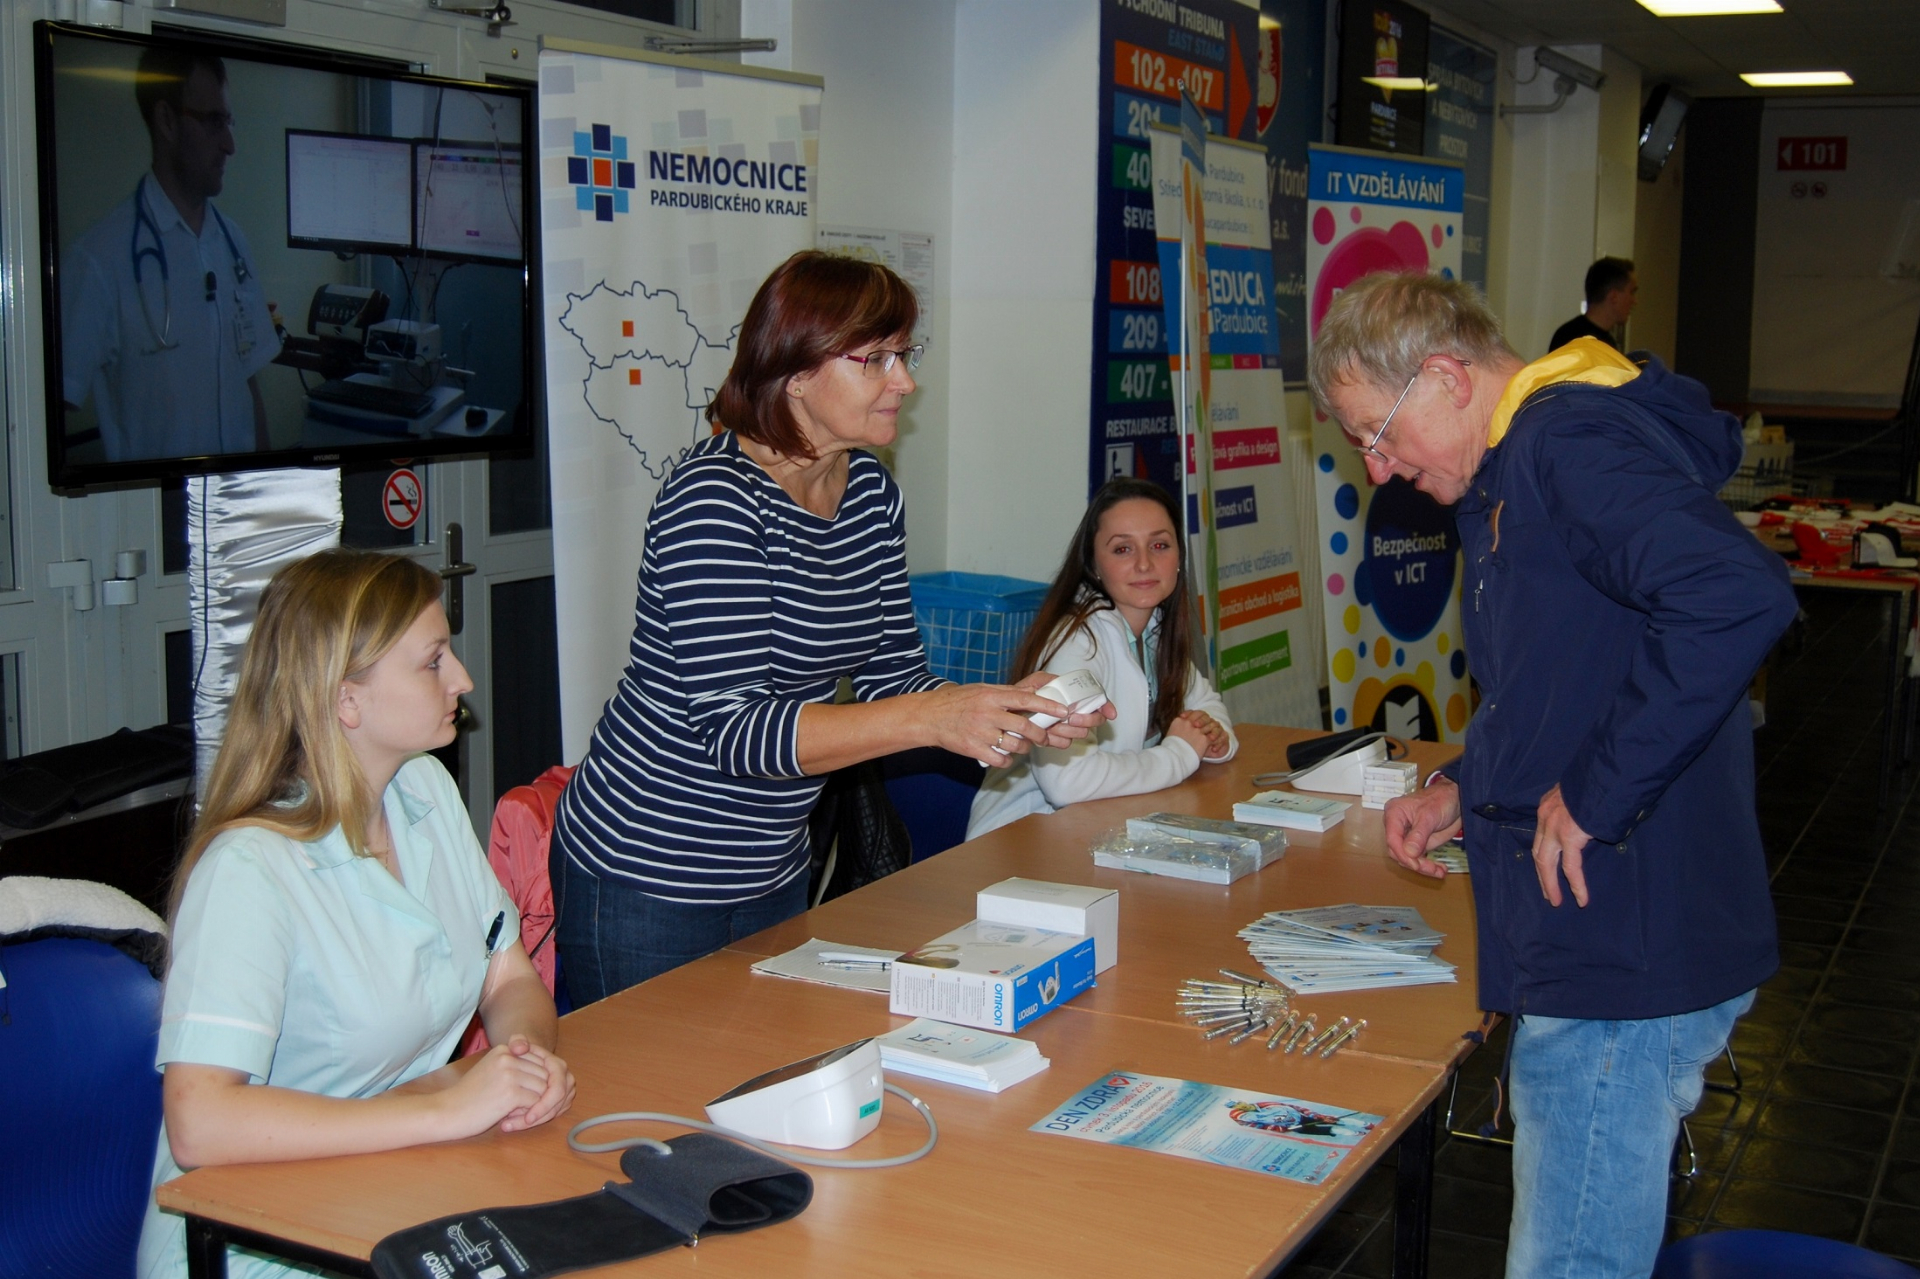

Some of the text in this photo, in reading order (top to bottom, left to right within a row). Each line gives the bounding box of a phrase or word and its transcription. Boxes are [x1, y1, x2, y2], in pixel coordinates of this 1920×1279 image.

[1179, 6, 1225, 40] TRIBUNA
[1168, 28, 1225, 62] EAST STAND
[1131, 49, 1166, 92] 102
[1182, 65, 1214, 104] 107
[1802, 142, 1837, 165] 101
[650, 150, 807, 192] NEMOCNICE
[1127, 152, 1152, 189] 40
[1279, 158, 1309, 200] fond
[1159, 179, 1182, 197] Střed
[1328, 171, 1445, 204] IT VZDĚLÁVÁNÍ
[651, 190, 807, 217] PARDUBICKÉHO KRAJE
[1123, 205, 1155, 231] SEVE
[1273, 218, 1291, 241] a.s.
[1126, 264, 1161, 301] 108
[1210, 268, 1265, 306] EDUCA
[1122, 314, 1158, 350] 209
[1214, 307, 1268, 335] Pardubice
[1120, 364, 1157, 399] 407
[1106, 416, 1168, 439] RESTAURACE
[313, 453, 340, 462] HYUNDAI
[1215, 501, 1237, 518] ečnost
[1242, 497, 1254, 514] ICT
[1373, 532, 1446, 559] Bezpečnost
[1395, 562, 1426, 585] v ICT
[1219, 598, 1244, 618] hraniční
[1272, 585, 1299, 606] logistika
[1095, 1109, 1133, 1133] Pardubická
[1131, 1086, 1164, 1109] nemocnice
[1105, 1094, 1137, 1111] listopadu
[1046, 1109, 1088, 1131] DEN
